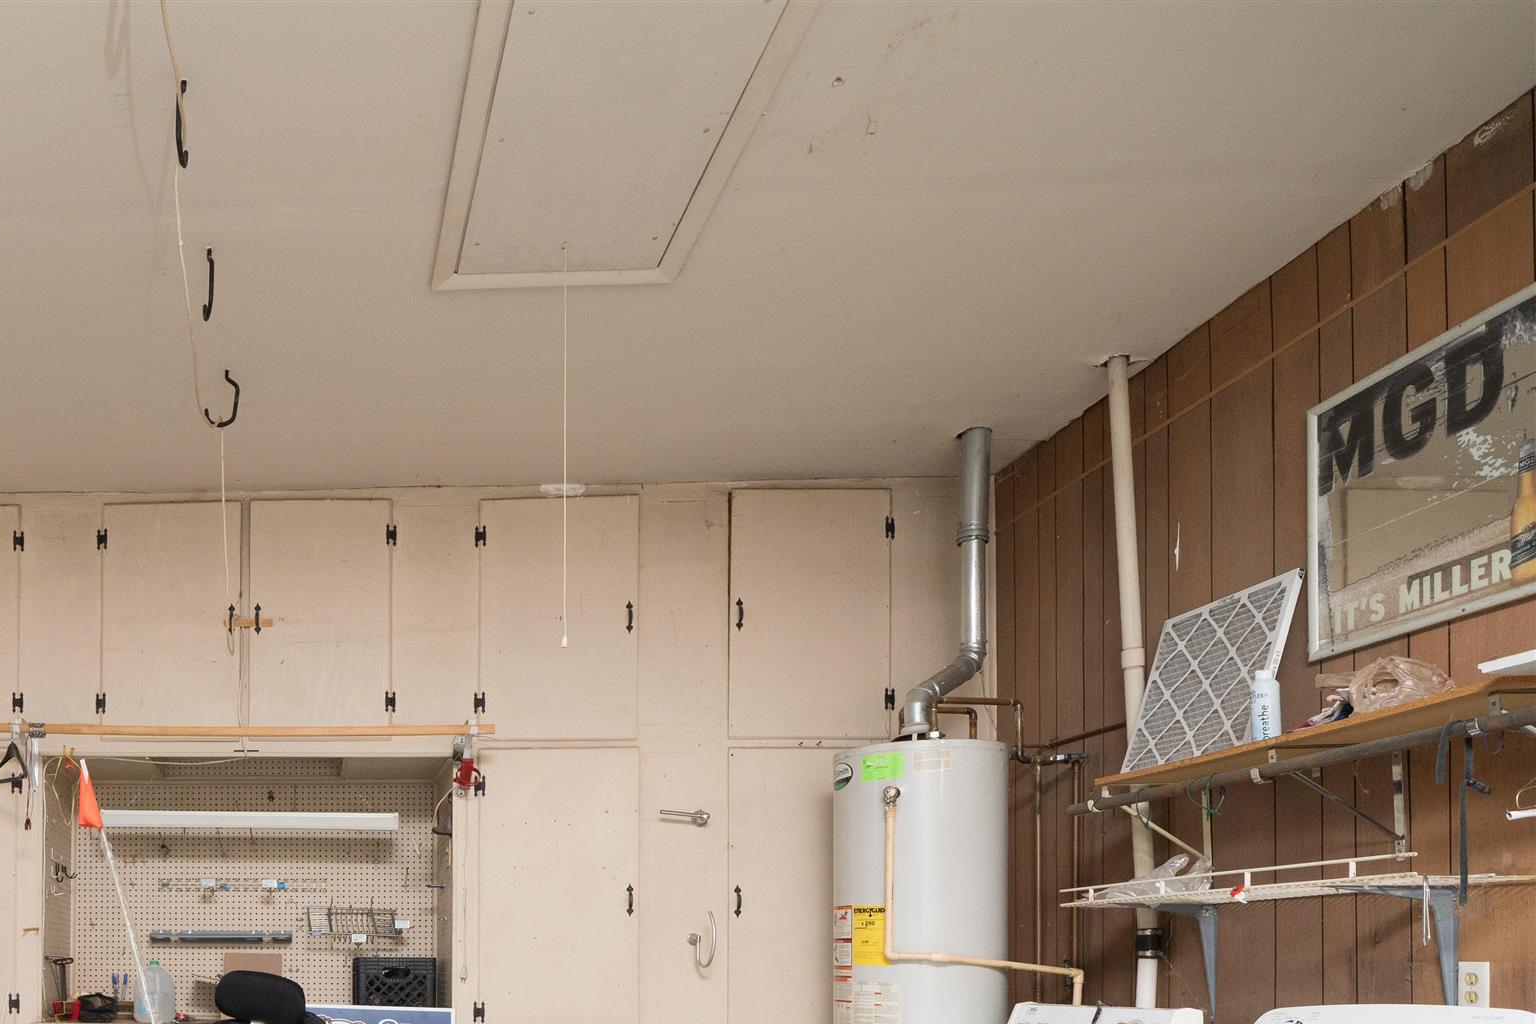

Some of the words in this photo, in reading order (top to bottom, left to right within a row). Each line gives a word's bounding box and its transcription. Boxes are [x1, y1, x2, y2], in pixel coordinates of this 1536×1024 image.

[1318, 324, 1505, 498] MGD
[1333, 592, 1386, 635] IT'S
[1398, 548, 1513, 614] MILLER
